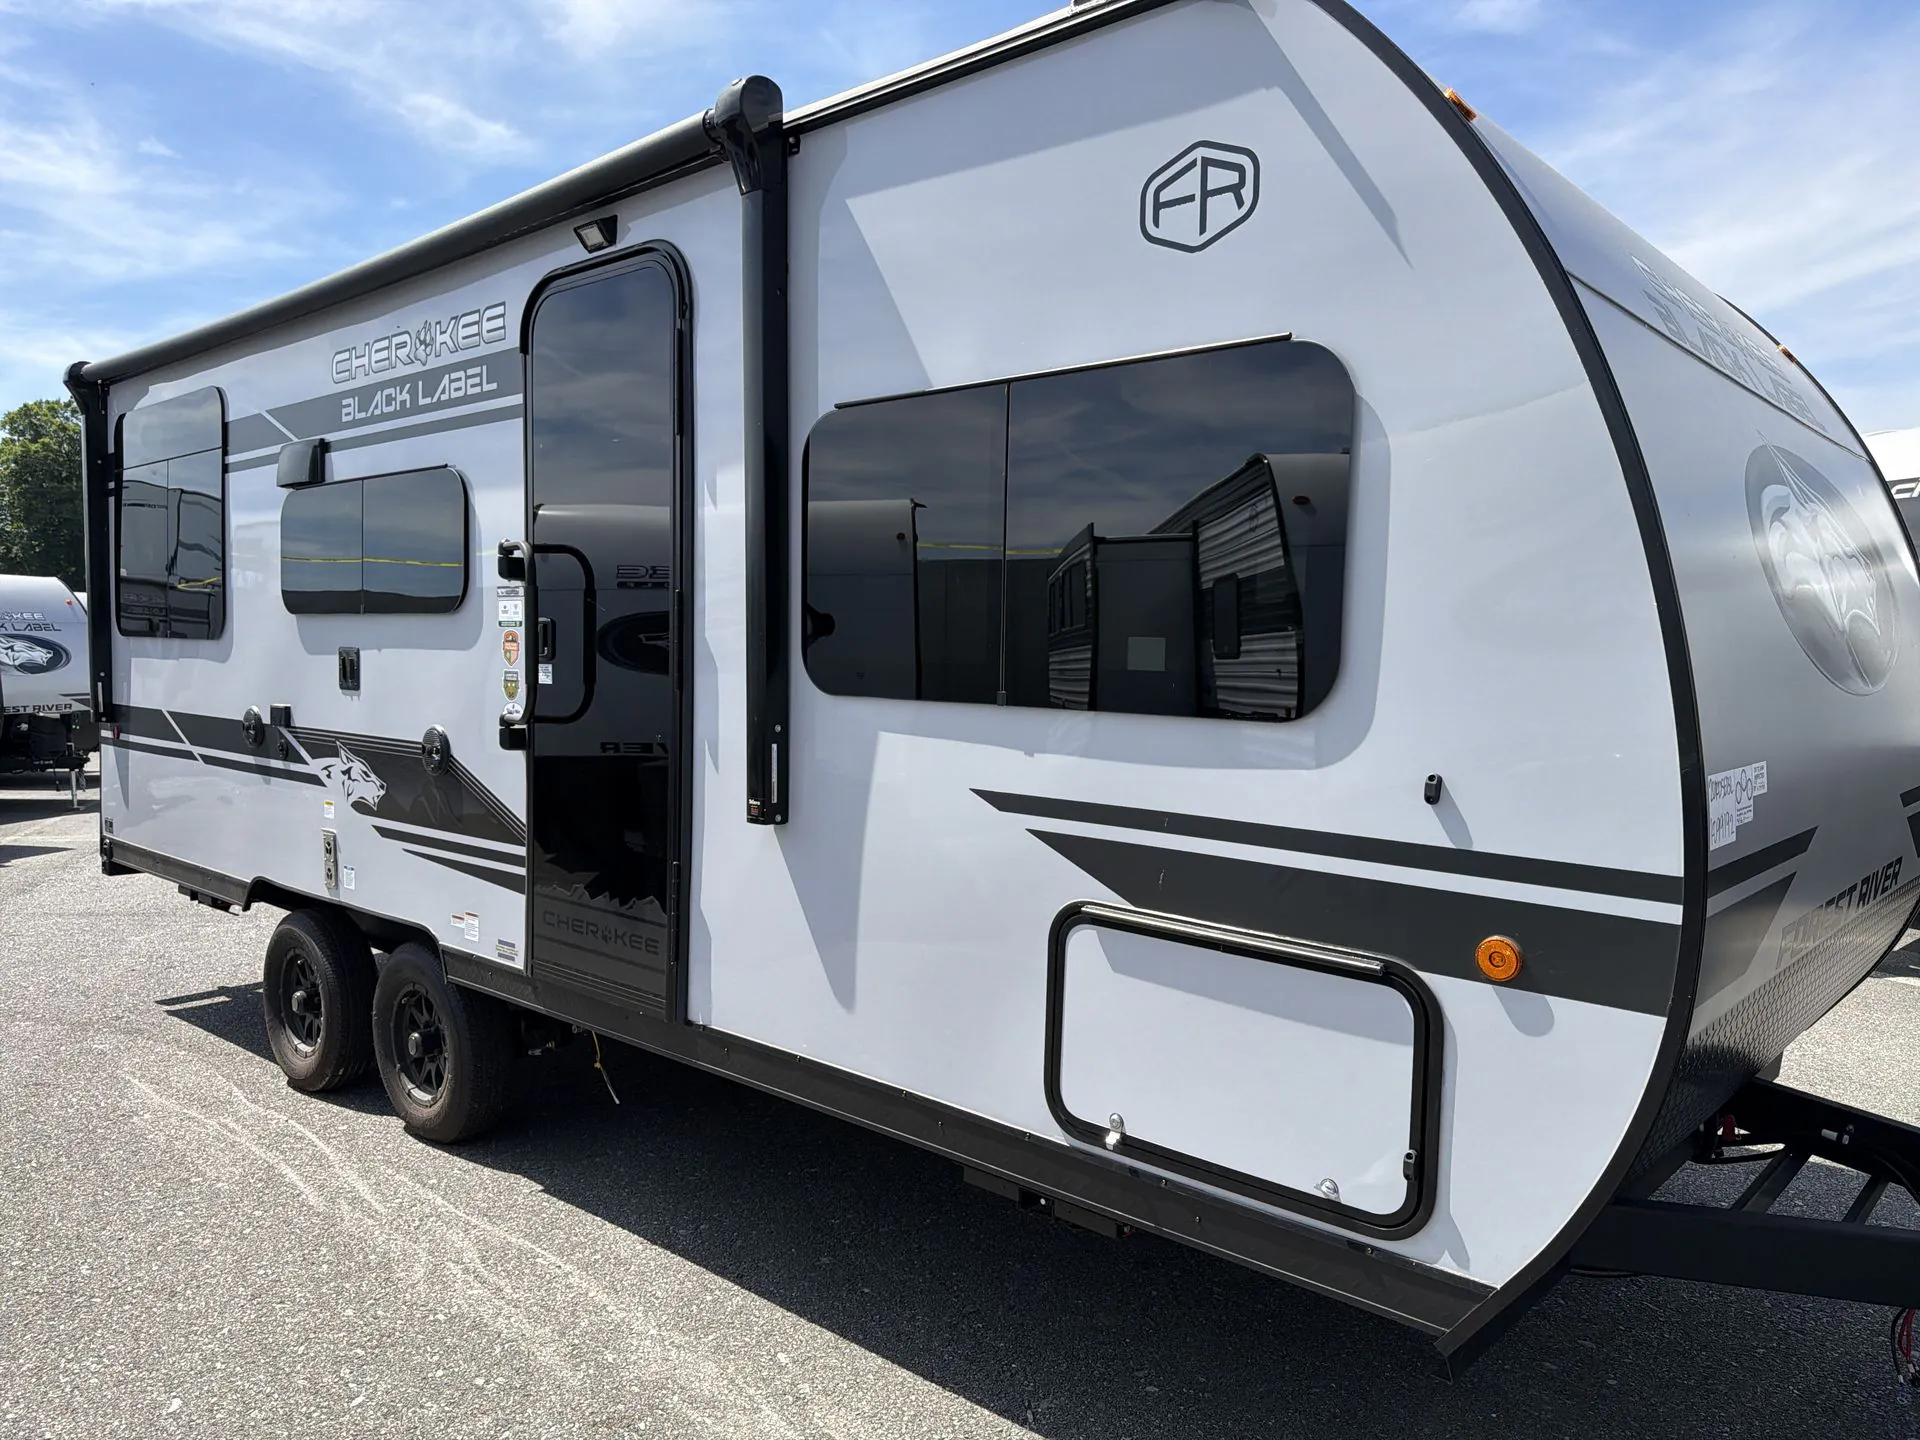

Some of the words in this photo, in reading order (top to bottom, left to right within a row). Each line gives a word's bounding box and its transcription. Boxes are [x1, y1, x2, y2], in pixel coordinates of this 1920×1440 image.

[341, 383, 411, 423] BLACK
[418, 364, 498, 406] LABEL
[11, 622, 62, 632] LABEL
[1857, 856, 1903, 909] RIVER
